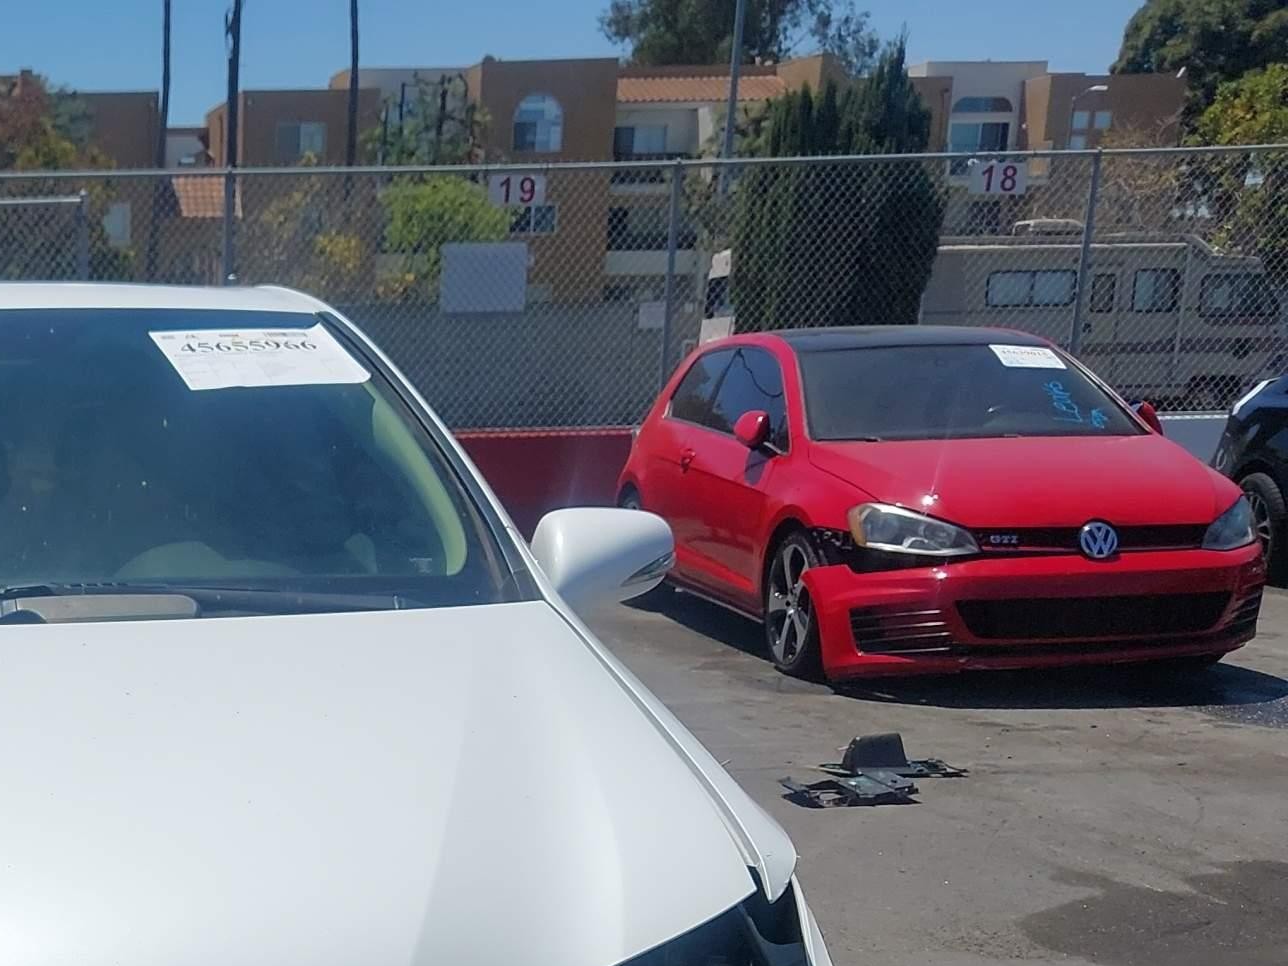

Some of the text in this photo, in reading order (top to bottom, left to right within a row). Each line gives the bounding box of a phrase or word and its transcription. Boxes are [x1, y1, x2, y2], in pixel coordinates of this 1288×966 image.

[982, 165, 1017, 192] 18
[500, 176, 535, 203] 19
[181, 340, 317, 353] 45655966
[990, 535, 1019, 544] GTI
